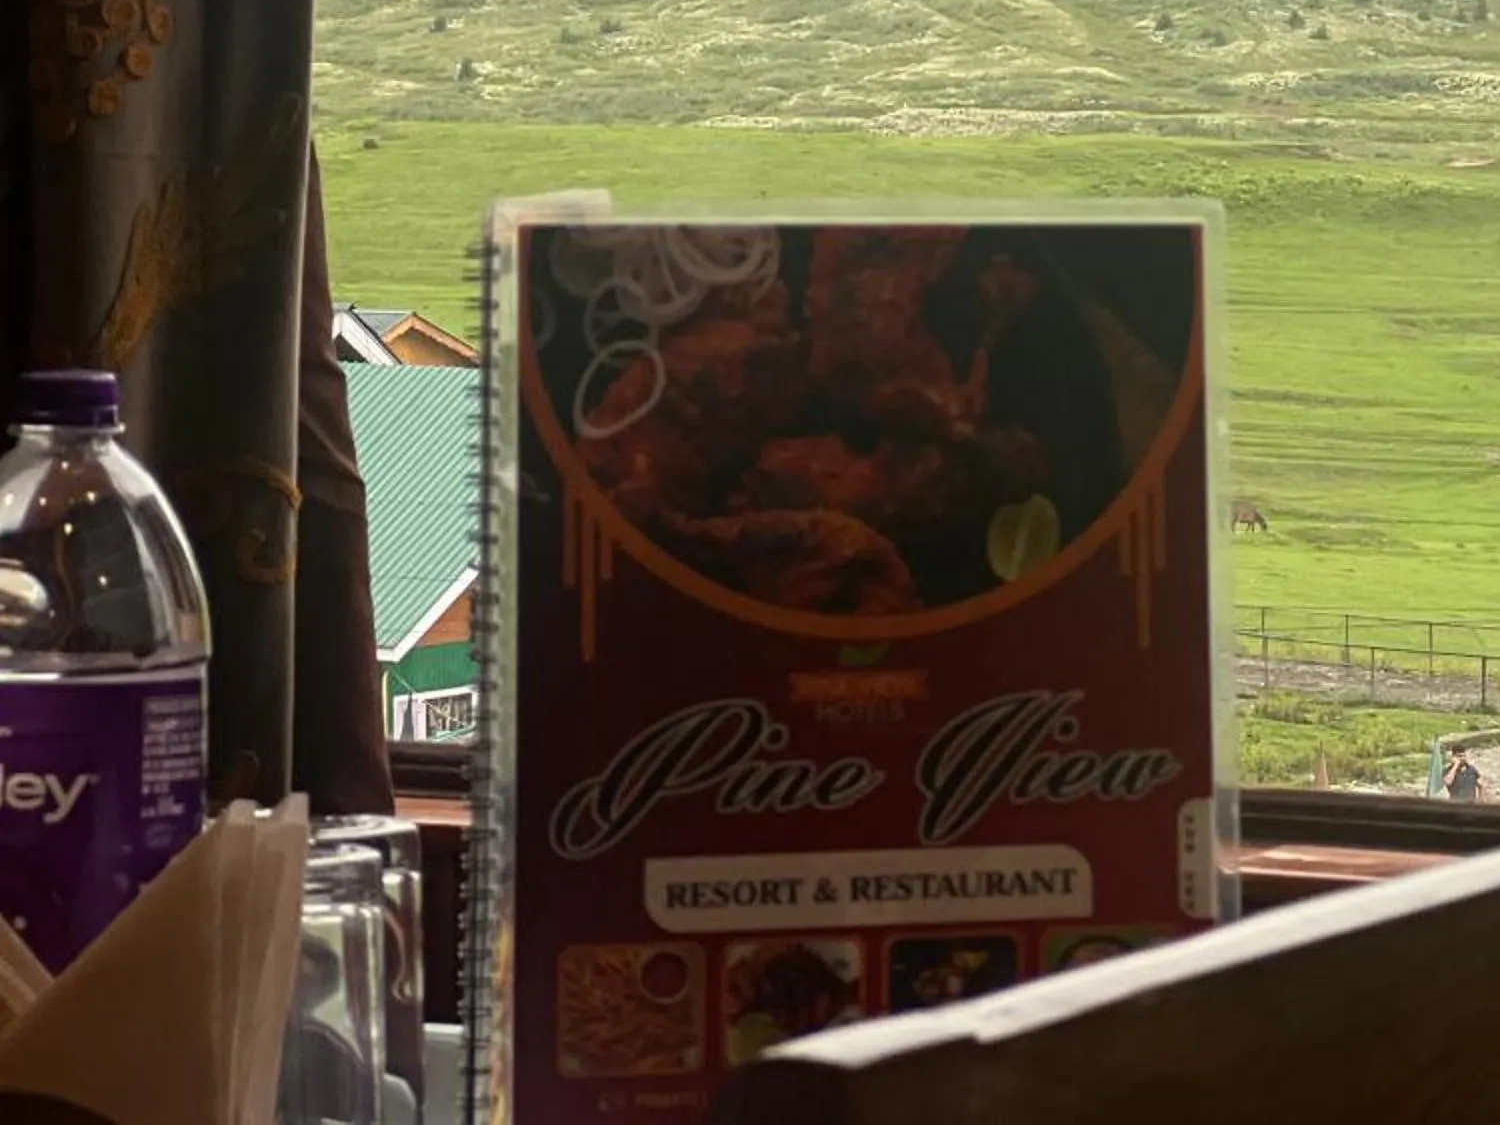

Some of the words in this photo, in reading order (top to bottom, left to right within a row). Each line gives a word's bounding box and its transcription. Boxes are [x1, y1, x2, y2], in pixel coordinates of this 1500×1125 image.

[548, 698, 886, 860] Pine
[915, 689, 1183, 845] View
[665, 877, 802, 910] RESORT
[812, 876, 839, 905] &
[849, 868, 1078, 903] RESTAURANT
